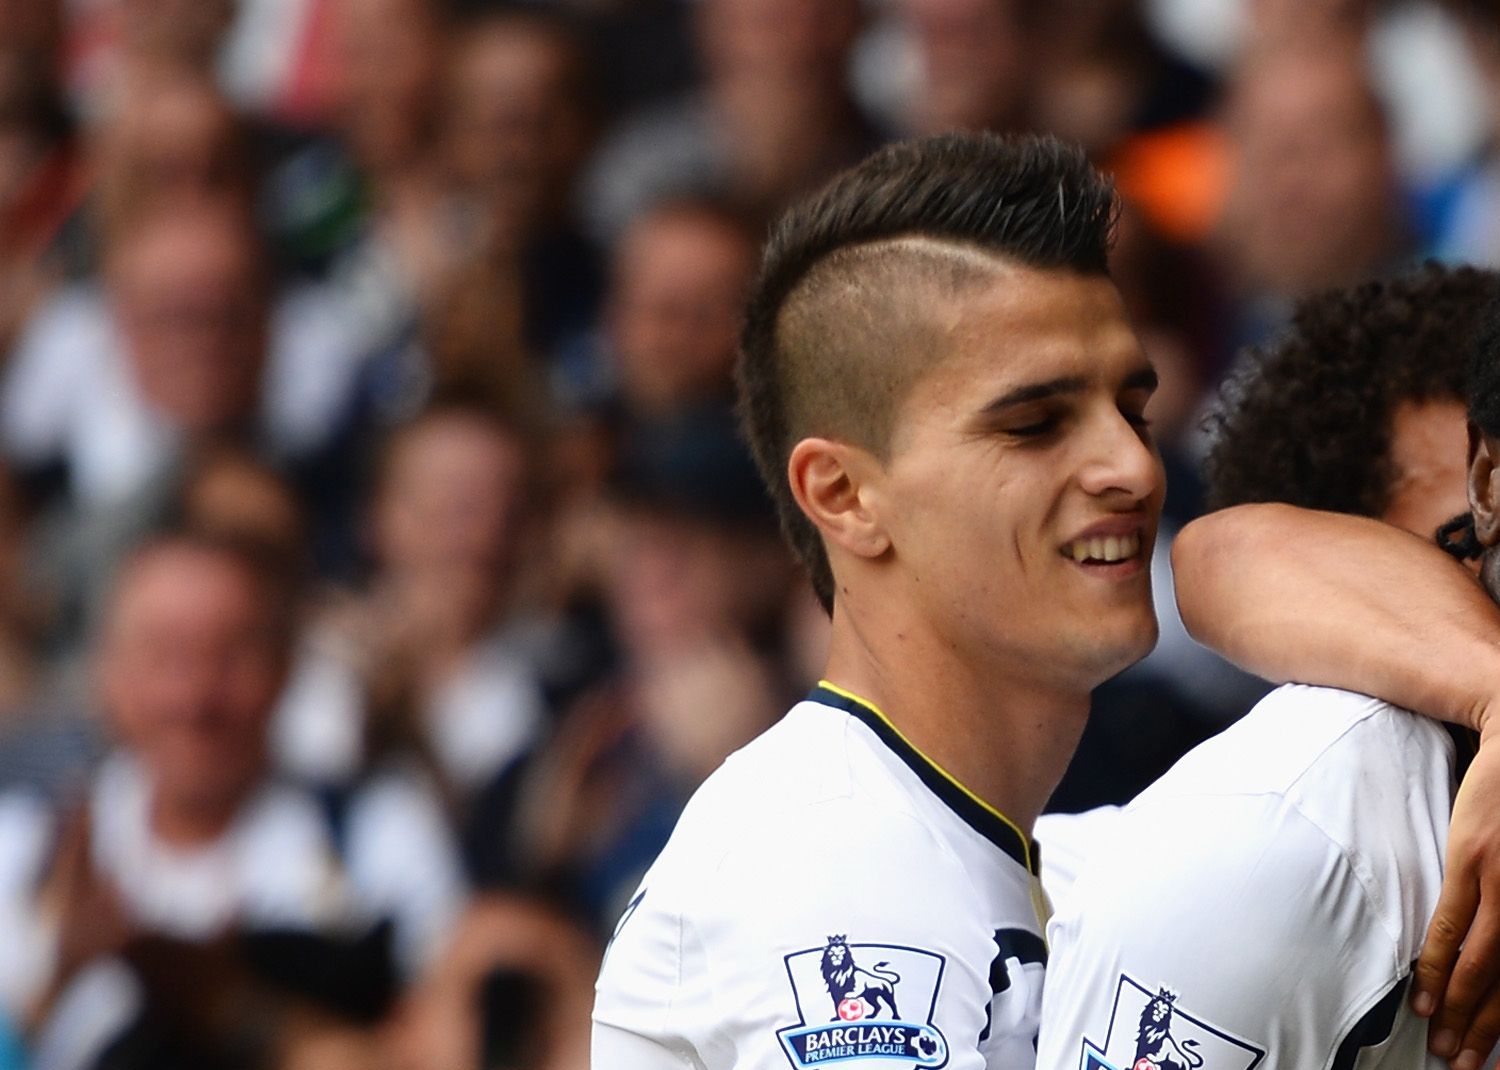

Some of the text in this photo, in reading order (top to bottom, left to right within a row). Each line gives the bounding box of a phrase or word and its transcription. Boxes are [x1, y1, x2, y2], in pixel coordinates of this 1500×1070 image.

[805, 1027, 906, 1051] BARCLAYS
[804, 1043, 906, 1063] PREMIER LEAGUE
